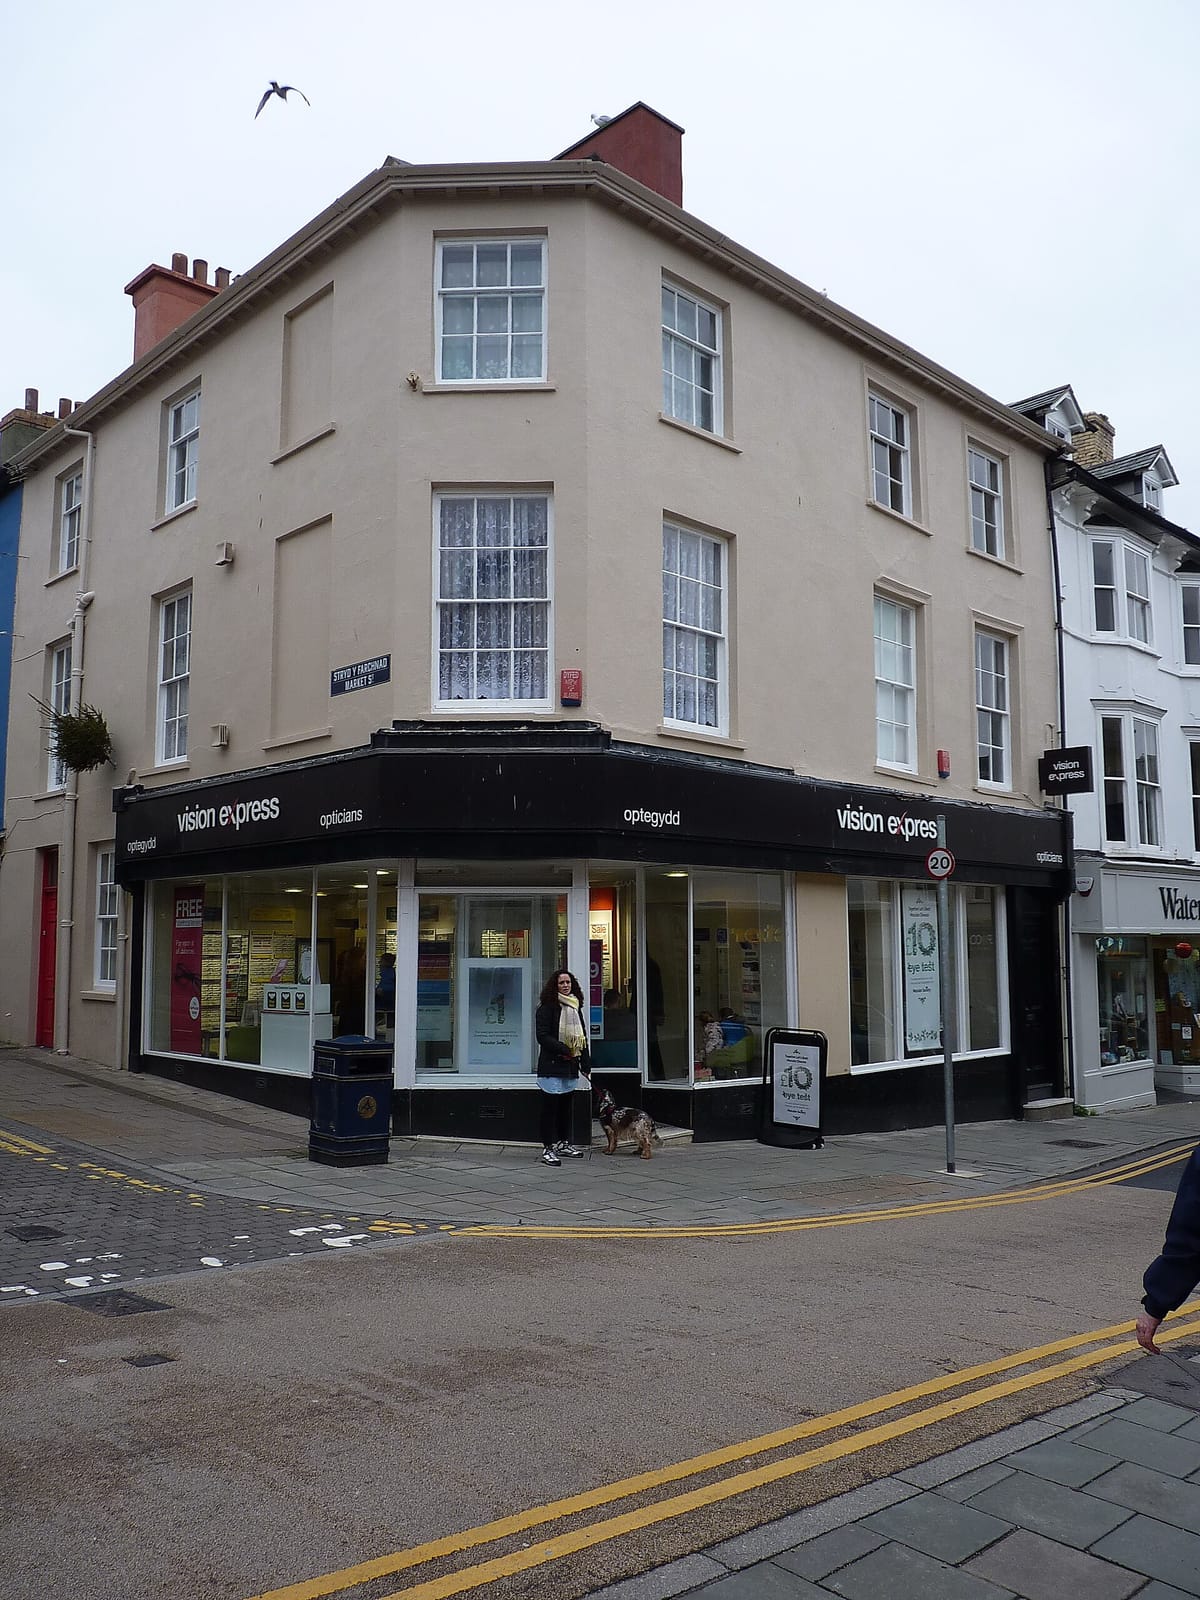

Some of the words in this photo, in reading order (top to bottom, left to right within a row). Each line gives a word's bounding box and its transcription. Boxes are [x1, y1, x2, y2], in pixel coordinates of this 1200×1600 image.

[333, 668, 352, 682] STRYD
[351, 665, 357, 677] Y
[344, 675, 368, 691] MARKET
[1053, 760, 1080, 771] vision
[1048, 770, 1085, 782] express
[177, 804, 216, 833] vision
[219, 797, 281, 831] express
[319, 808, 363, 830] opticians
[623, 807, 681, 829] optegydd
[836, 803, 884, 833] vision
[887, 810, 938, 842] expres
[127, 836, 157, 855] optegydd
[930, 856, 950, 870] 20
[1036, 851, 1063, 864] opticians
[175, 899, 203, 918] FREE
[907, 963, 920, 975] eye
[921, 961, 935, 972] test
